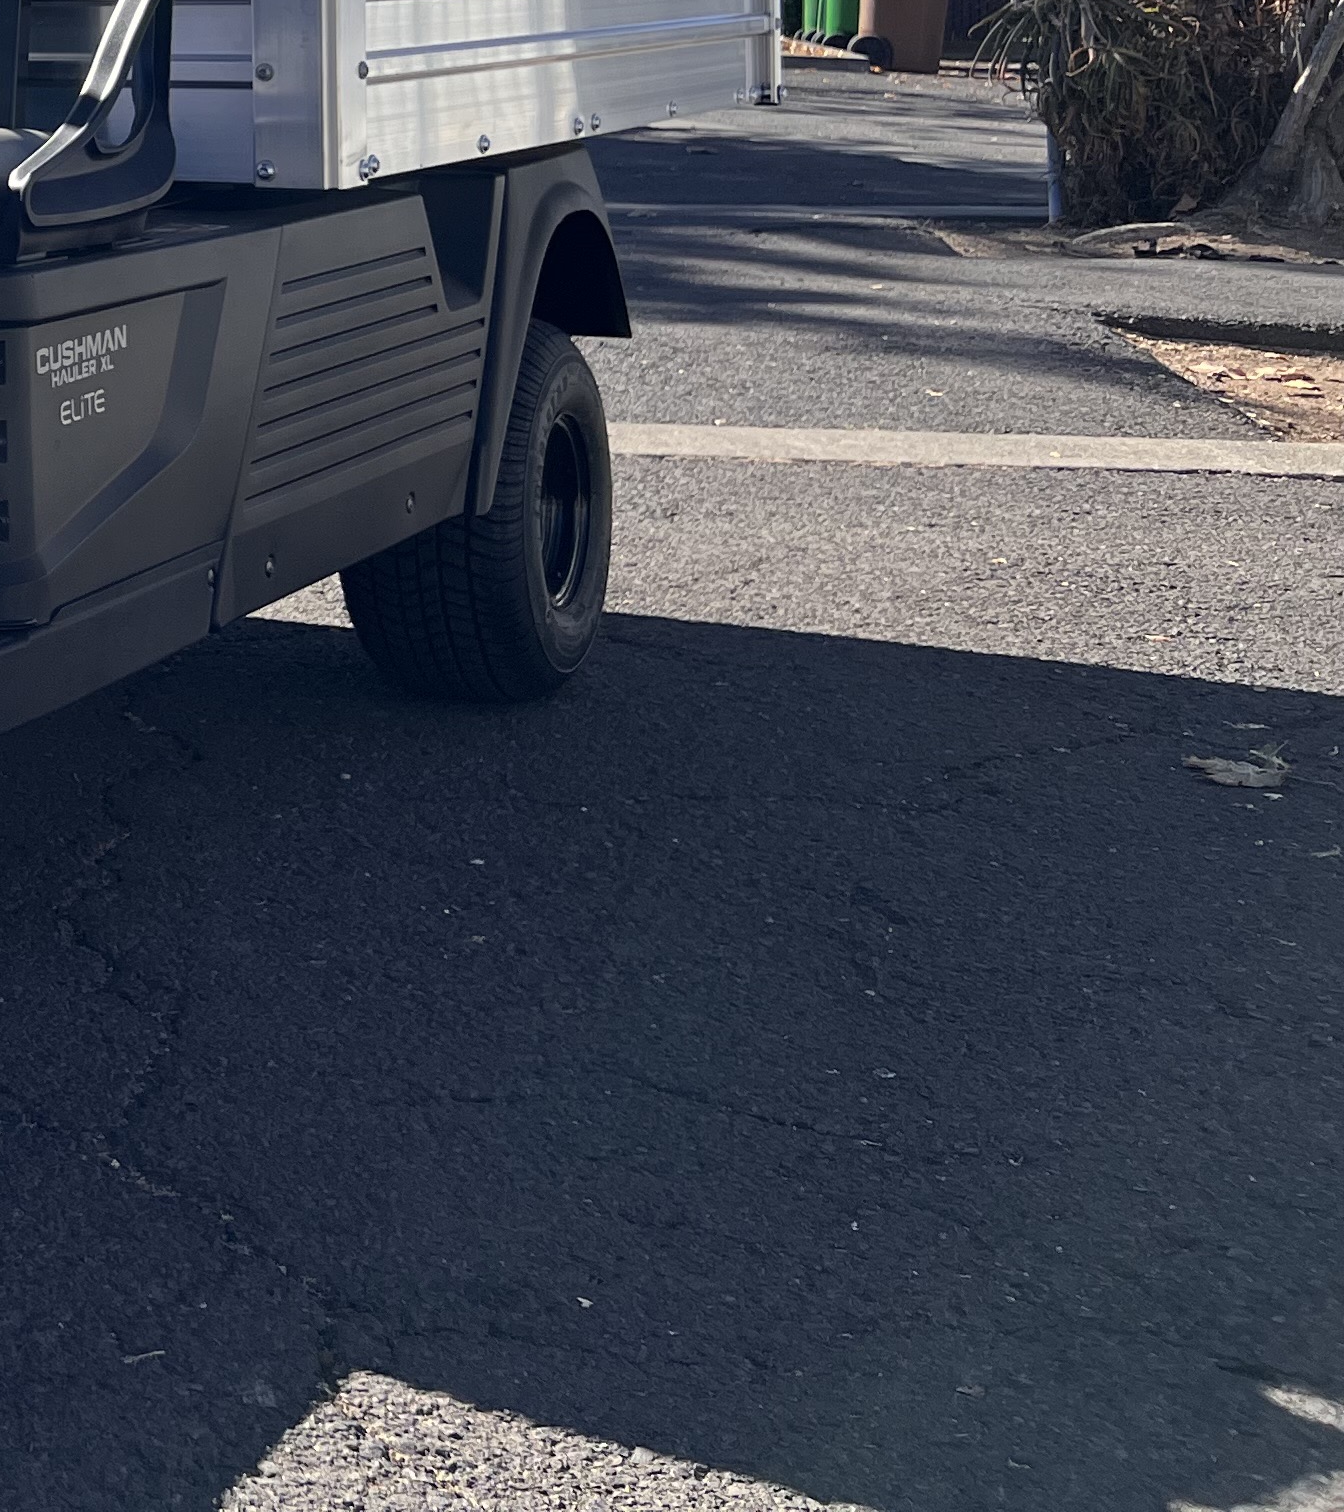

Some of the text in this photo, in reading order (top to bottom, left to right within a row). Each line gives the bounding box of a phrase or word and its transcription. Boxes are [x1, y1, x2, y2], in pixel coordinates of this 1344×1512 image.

[36, 324, 127, 375] CUSHMAN
[51, 354, 115, 388] HAULER XL
